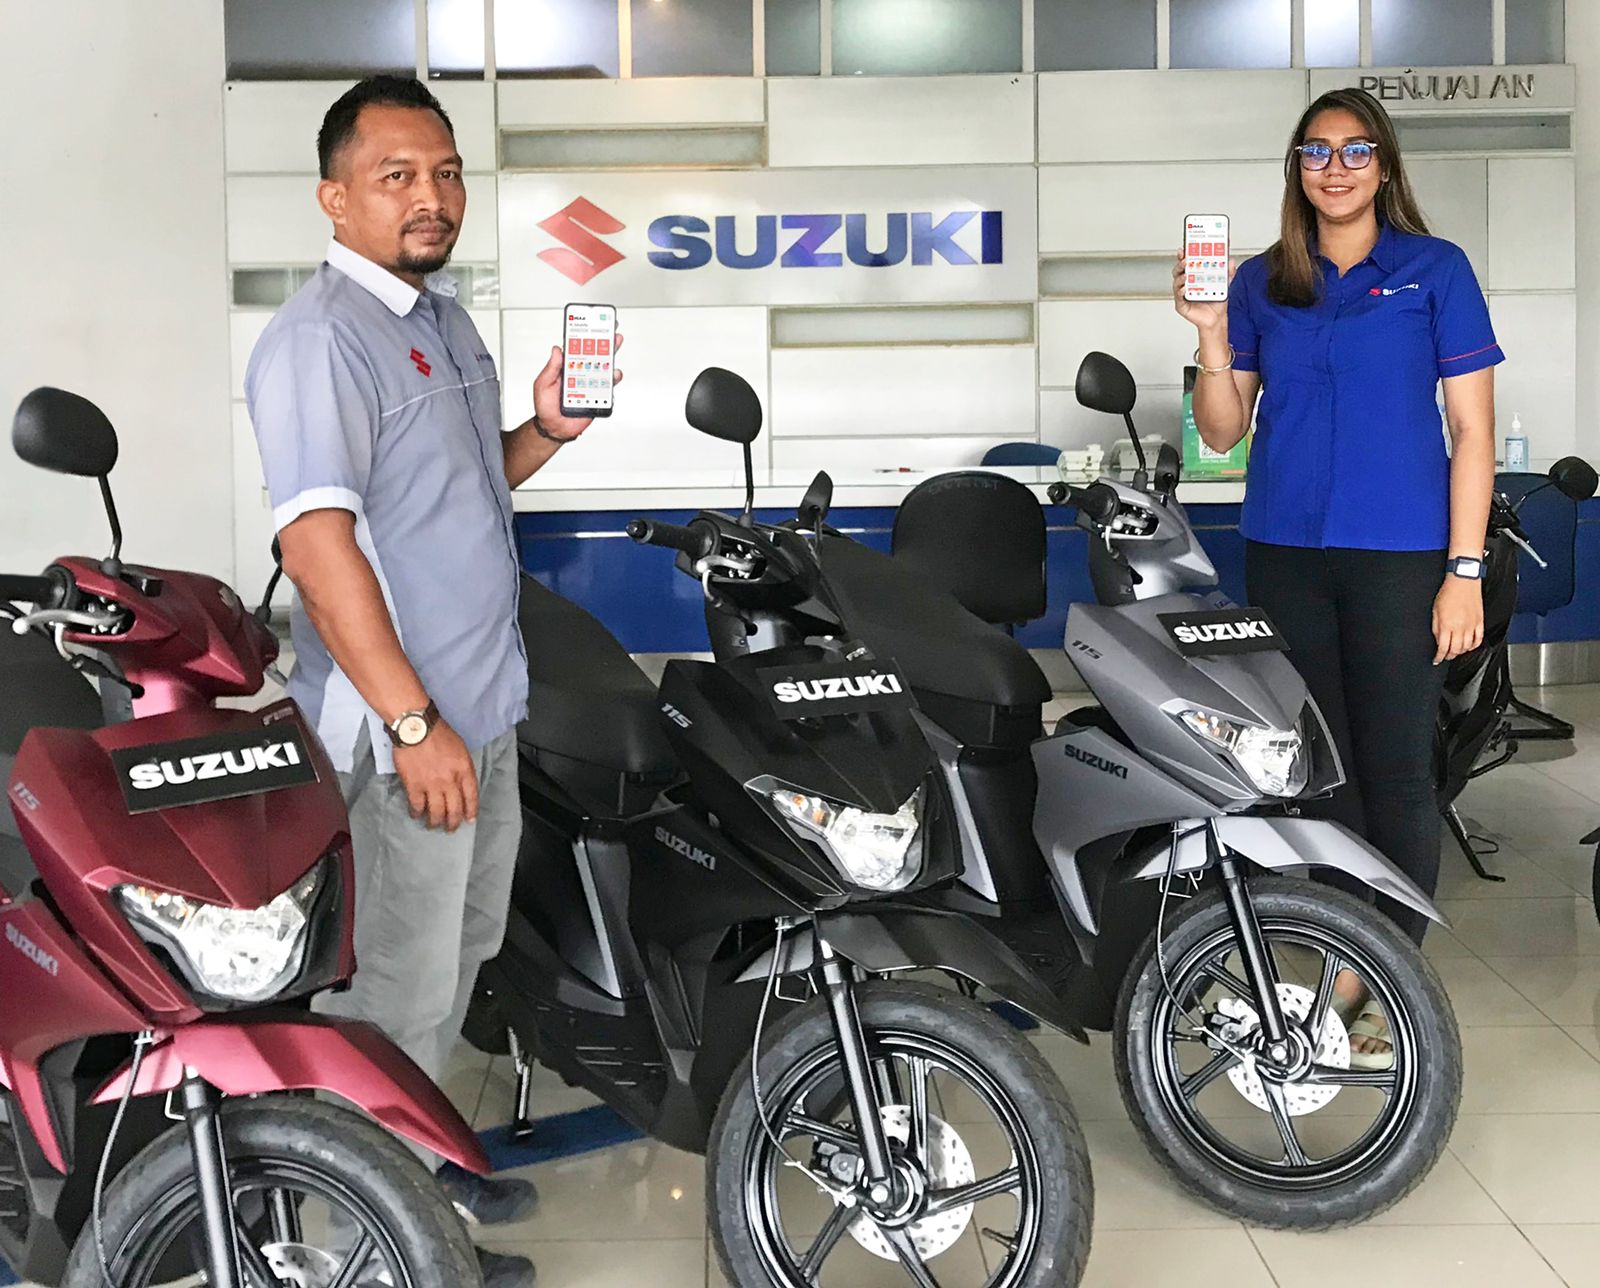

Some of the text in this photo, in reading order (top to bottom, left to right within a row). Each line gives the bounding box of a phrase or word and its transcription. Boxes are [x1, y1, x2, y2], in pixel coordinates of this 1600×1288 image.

[1359, 74, 1535, 101] PENJUALAN
[647, 210, 1003, 270] SUZUKI
[1174, 620, 1274, 644] SUZUKI
[1071, 639, 1103, 660] 115
[773, 673, 903, 704] SUZUKI
[660, 702, 693, 729] 115
[128, 741, 301, 790] SUZUKI
[1064, 743, 1129, 780] SUZUKI
[13, 781, 41, 811] 115
[654, 826, 716, 870] SUZUKI
[5, 921, 58, 976] SUZUKI
